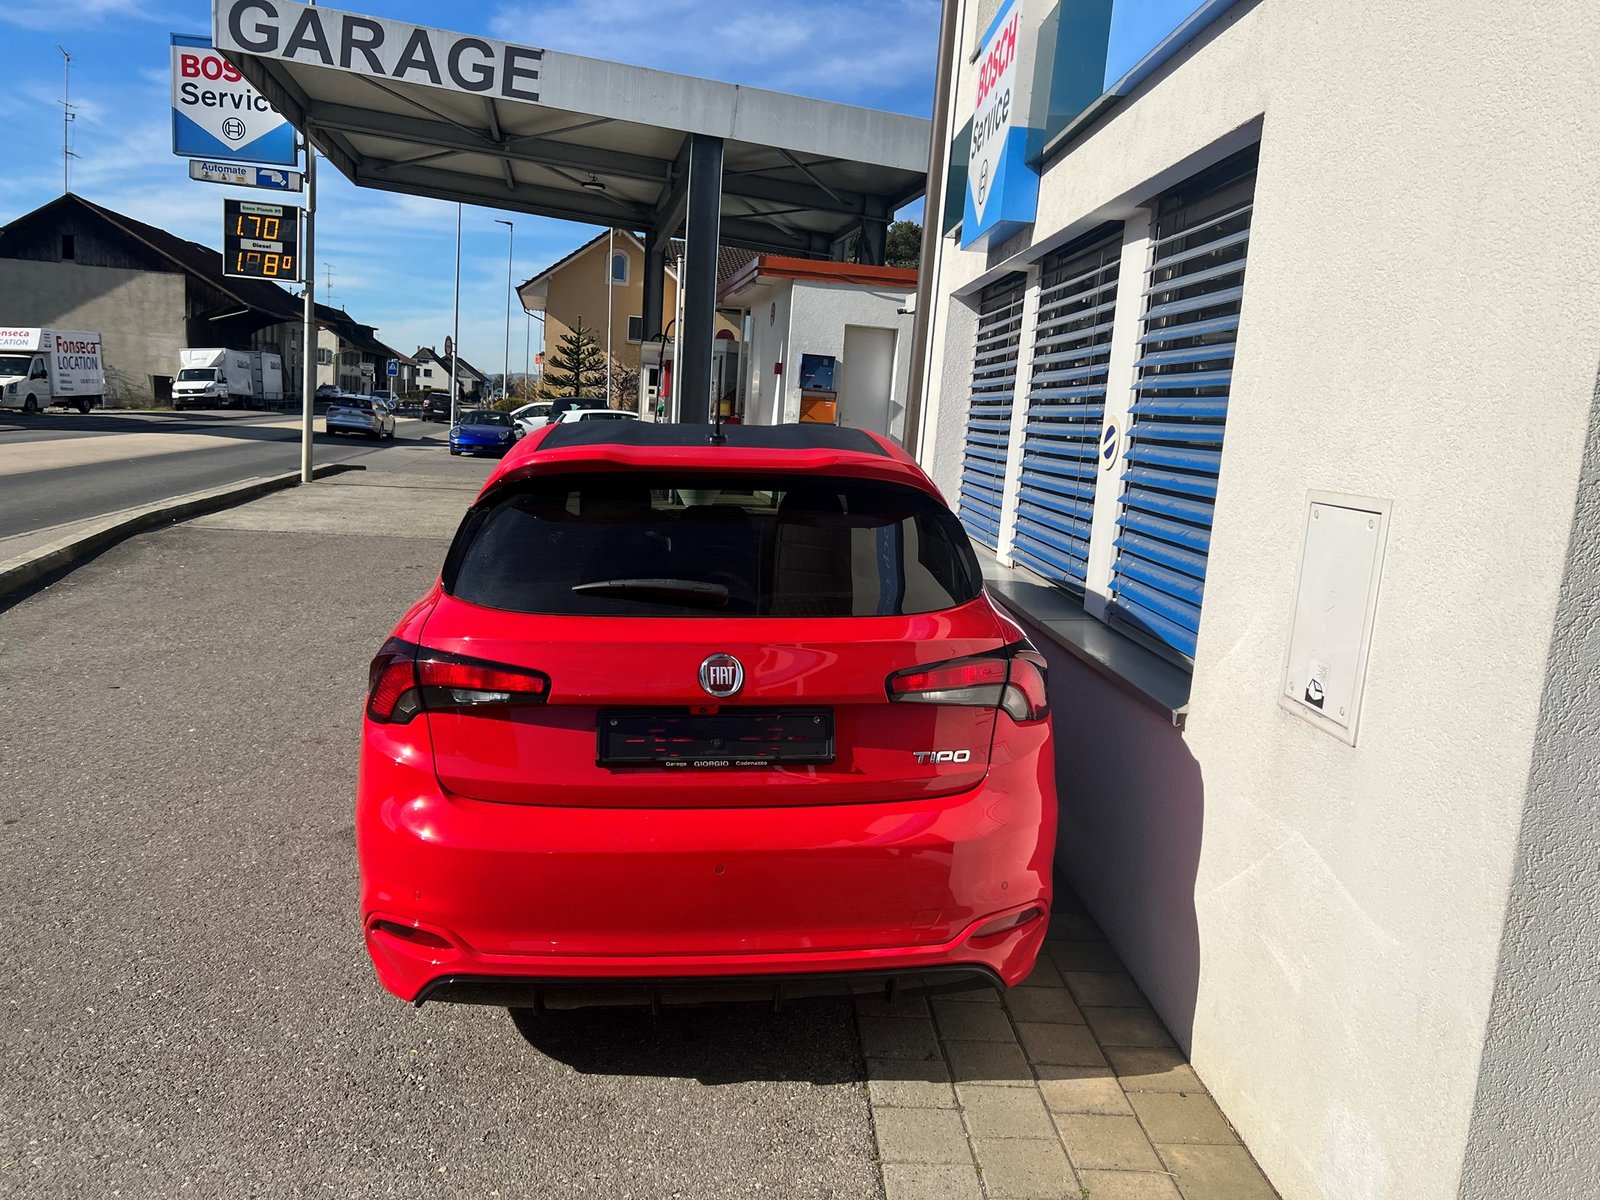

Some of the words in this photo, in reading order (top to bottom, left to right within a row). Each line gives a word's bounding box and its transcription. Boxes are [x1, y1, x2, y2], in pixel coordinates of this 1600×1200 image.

[228, 0, 541, 102] GARAGE
[976, 12, 1019, 109] BOSCH
[181, 54, 242, 83] BOS
[180, 82, 281, 114] Servic
[971, 88, 1010, 160] Service
[201, 163, 247, 176] Automate
[237, 215, 279, 240] 1.70
[252, 242, 272, 250] Diesel
[55, 335, 97, 354] Fonseca
[57, 355, 98, 370] LOCATION
[710, 666, 734, 686] FIAT
[913, 749, 971, 764] TIPO
